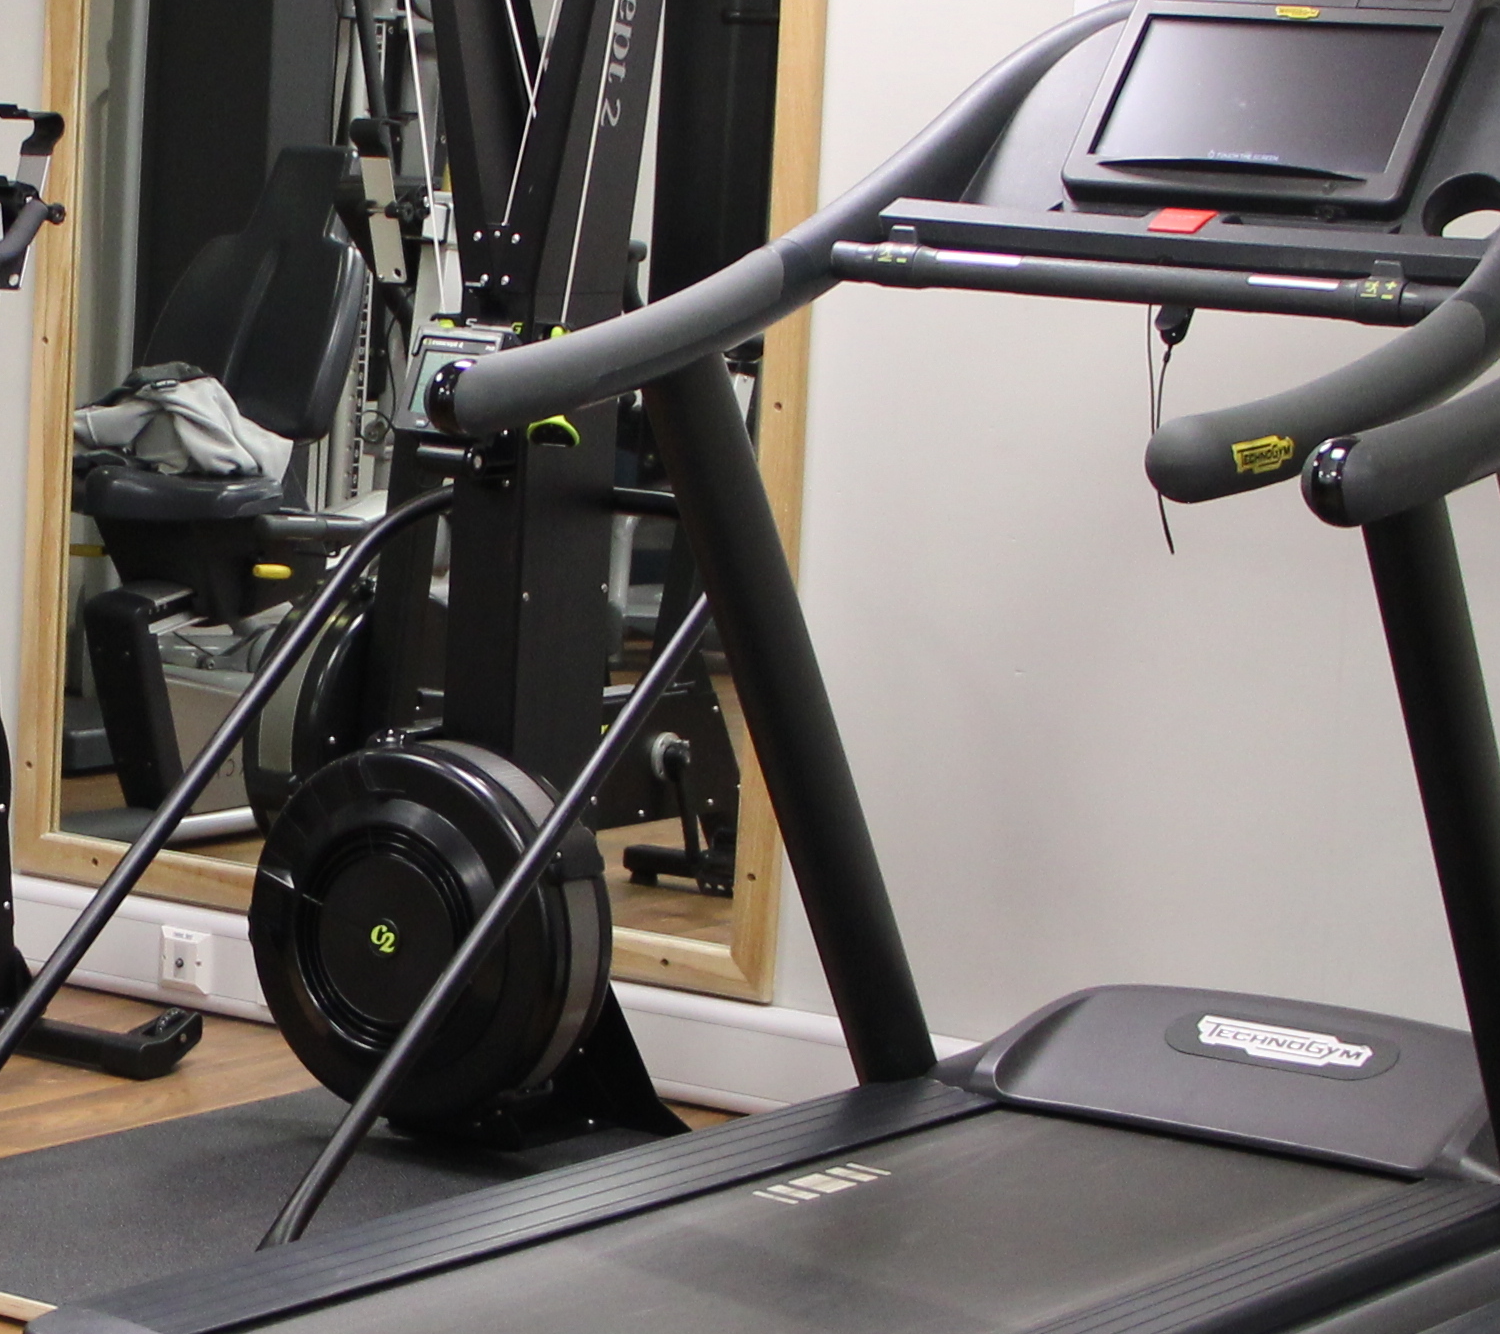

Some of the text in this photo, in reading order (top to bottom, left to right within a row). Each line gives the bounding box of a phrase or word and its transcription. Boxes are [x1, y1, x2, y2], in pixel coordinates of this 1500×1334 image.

[600, 97, 621, 128] 2
[371, 924, 395, 953] C2
[1206, 1020, 1364, 1061] TECHNOGYM
